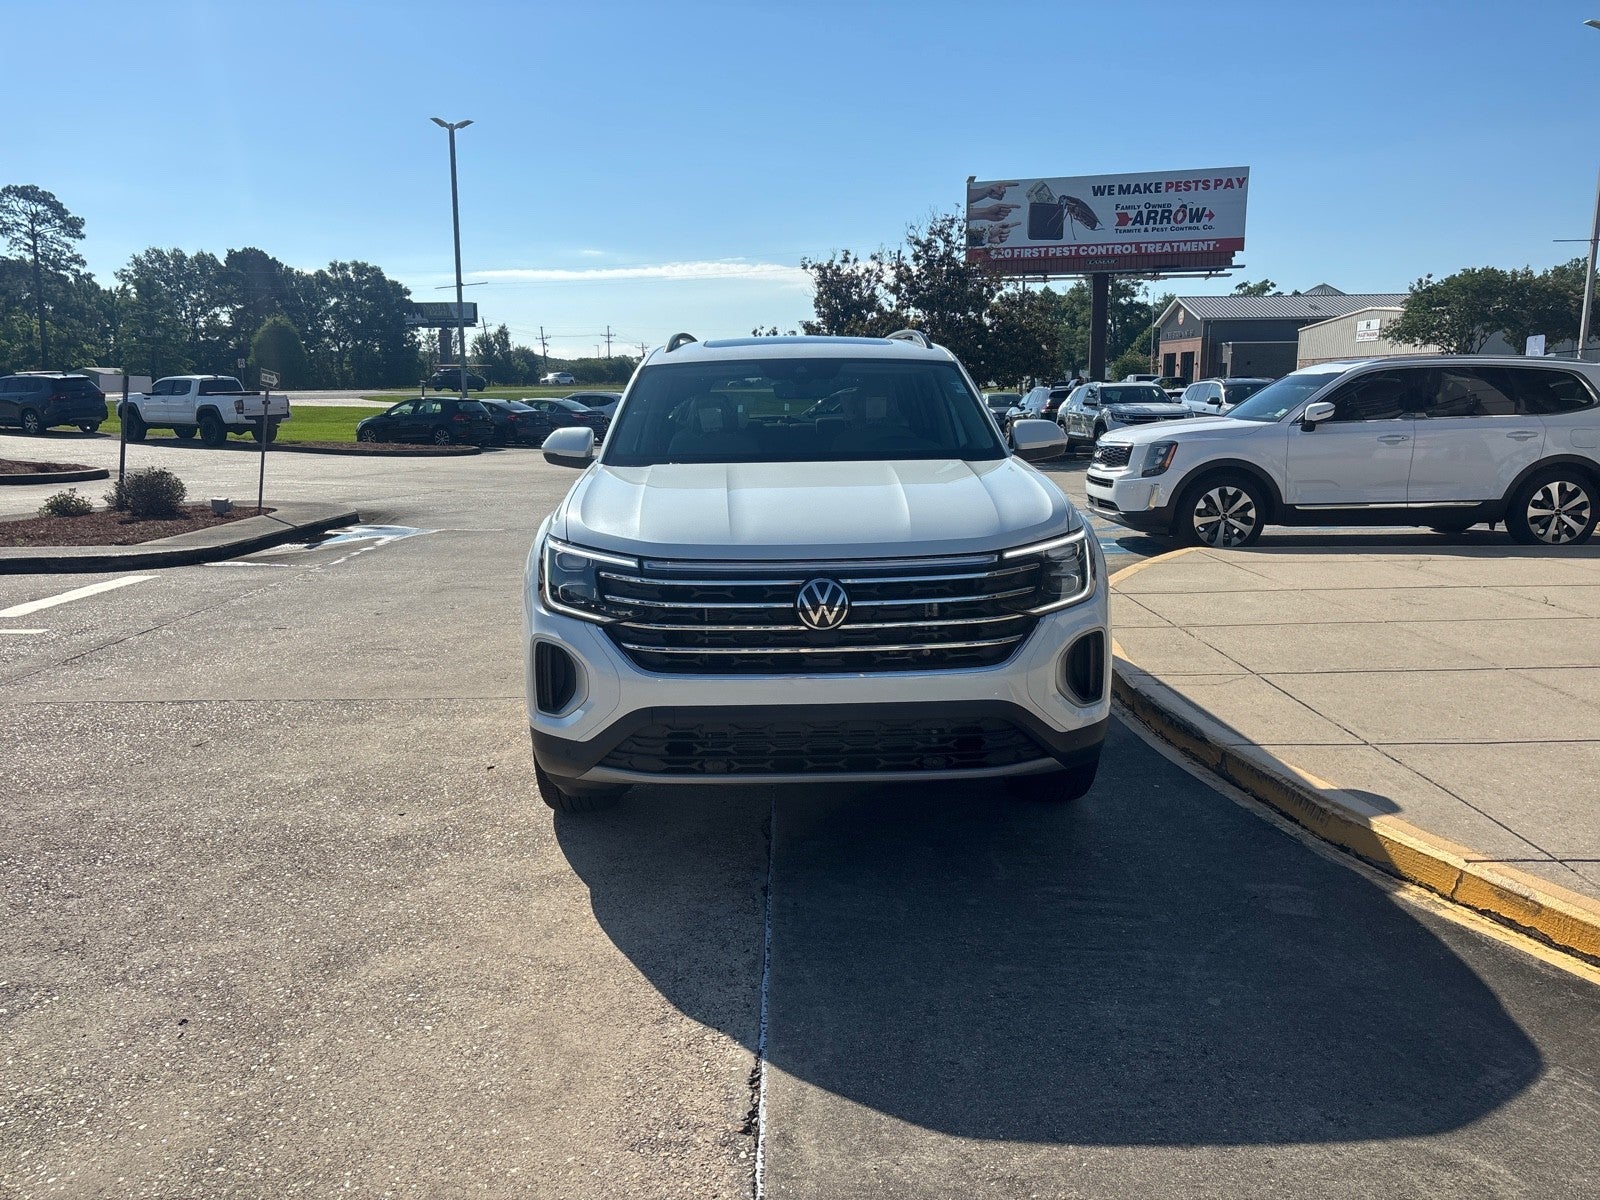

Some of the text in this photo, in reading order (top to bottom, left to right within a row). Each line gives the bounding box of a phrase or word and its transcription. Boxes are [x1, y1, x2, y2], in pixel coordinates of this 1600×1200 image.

[1092, 177, 1246, 196] WE MAKE PESTS PAY
[1131, 206, 1206, 226] ARROW
[1013, 248, 1046, 258] FIRST
[1048, 246, 1078, 257] PEST
[1079, 244, 1137, 255] CONTROL
[799, 580, 846, 627] VW
